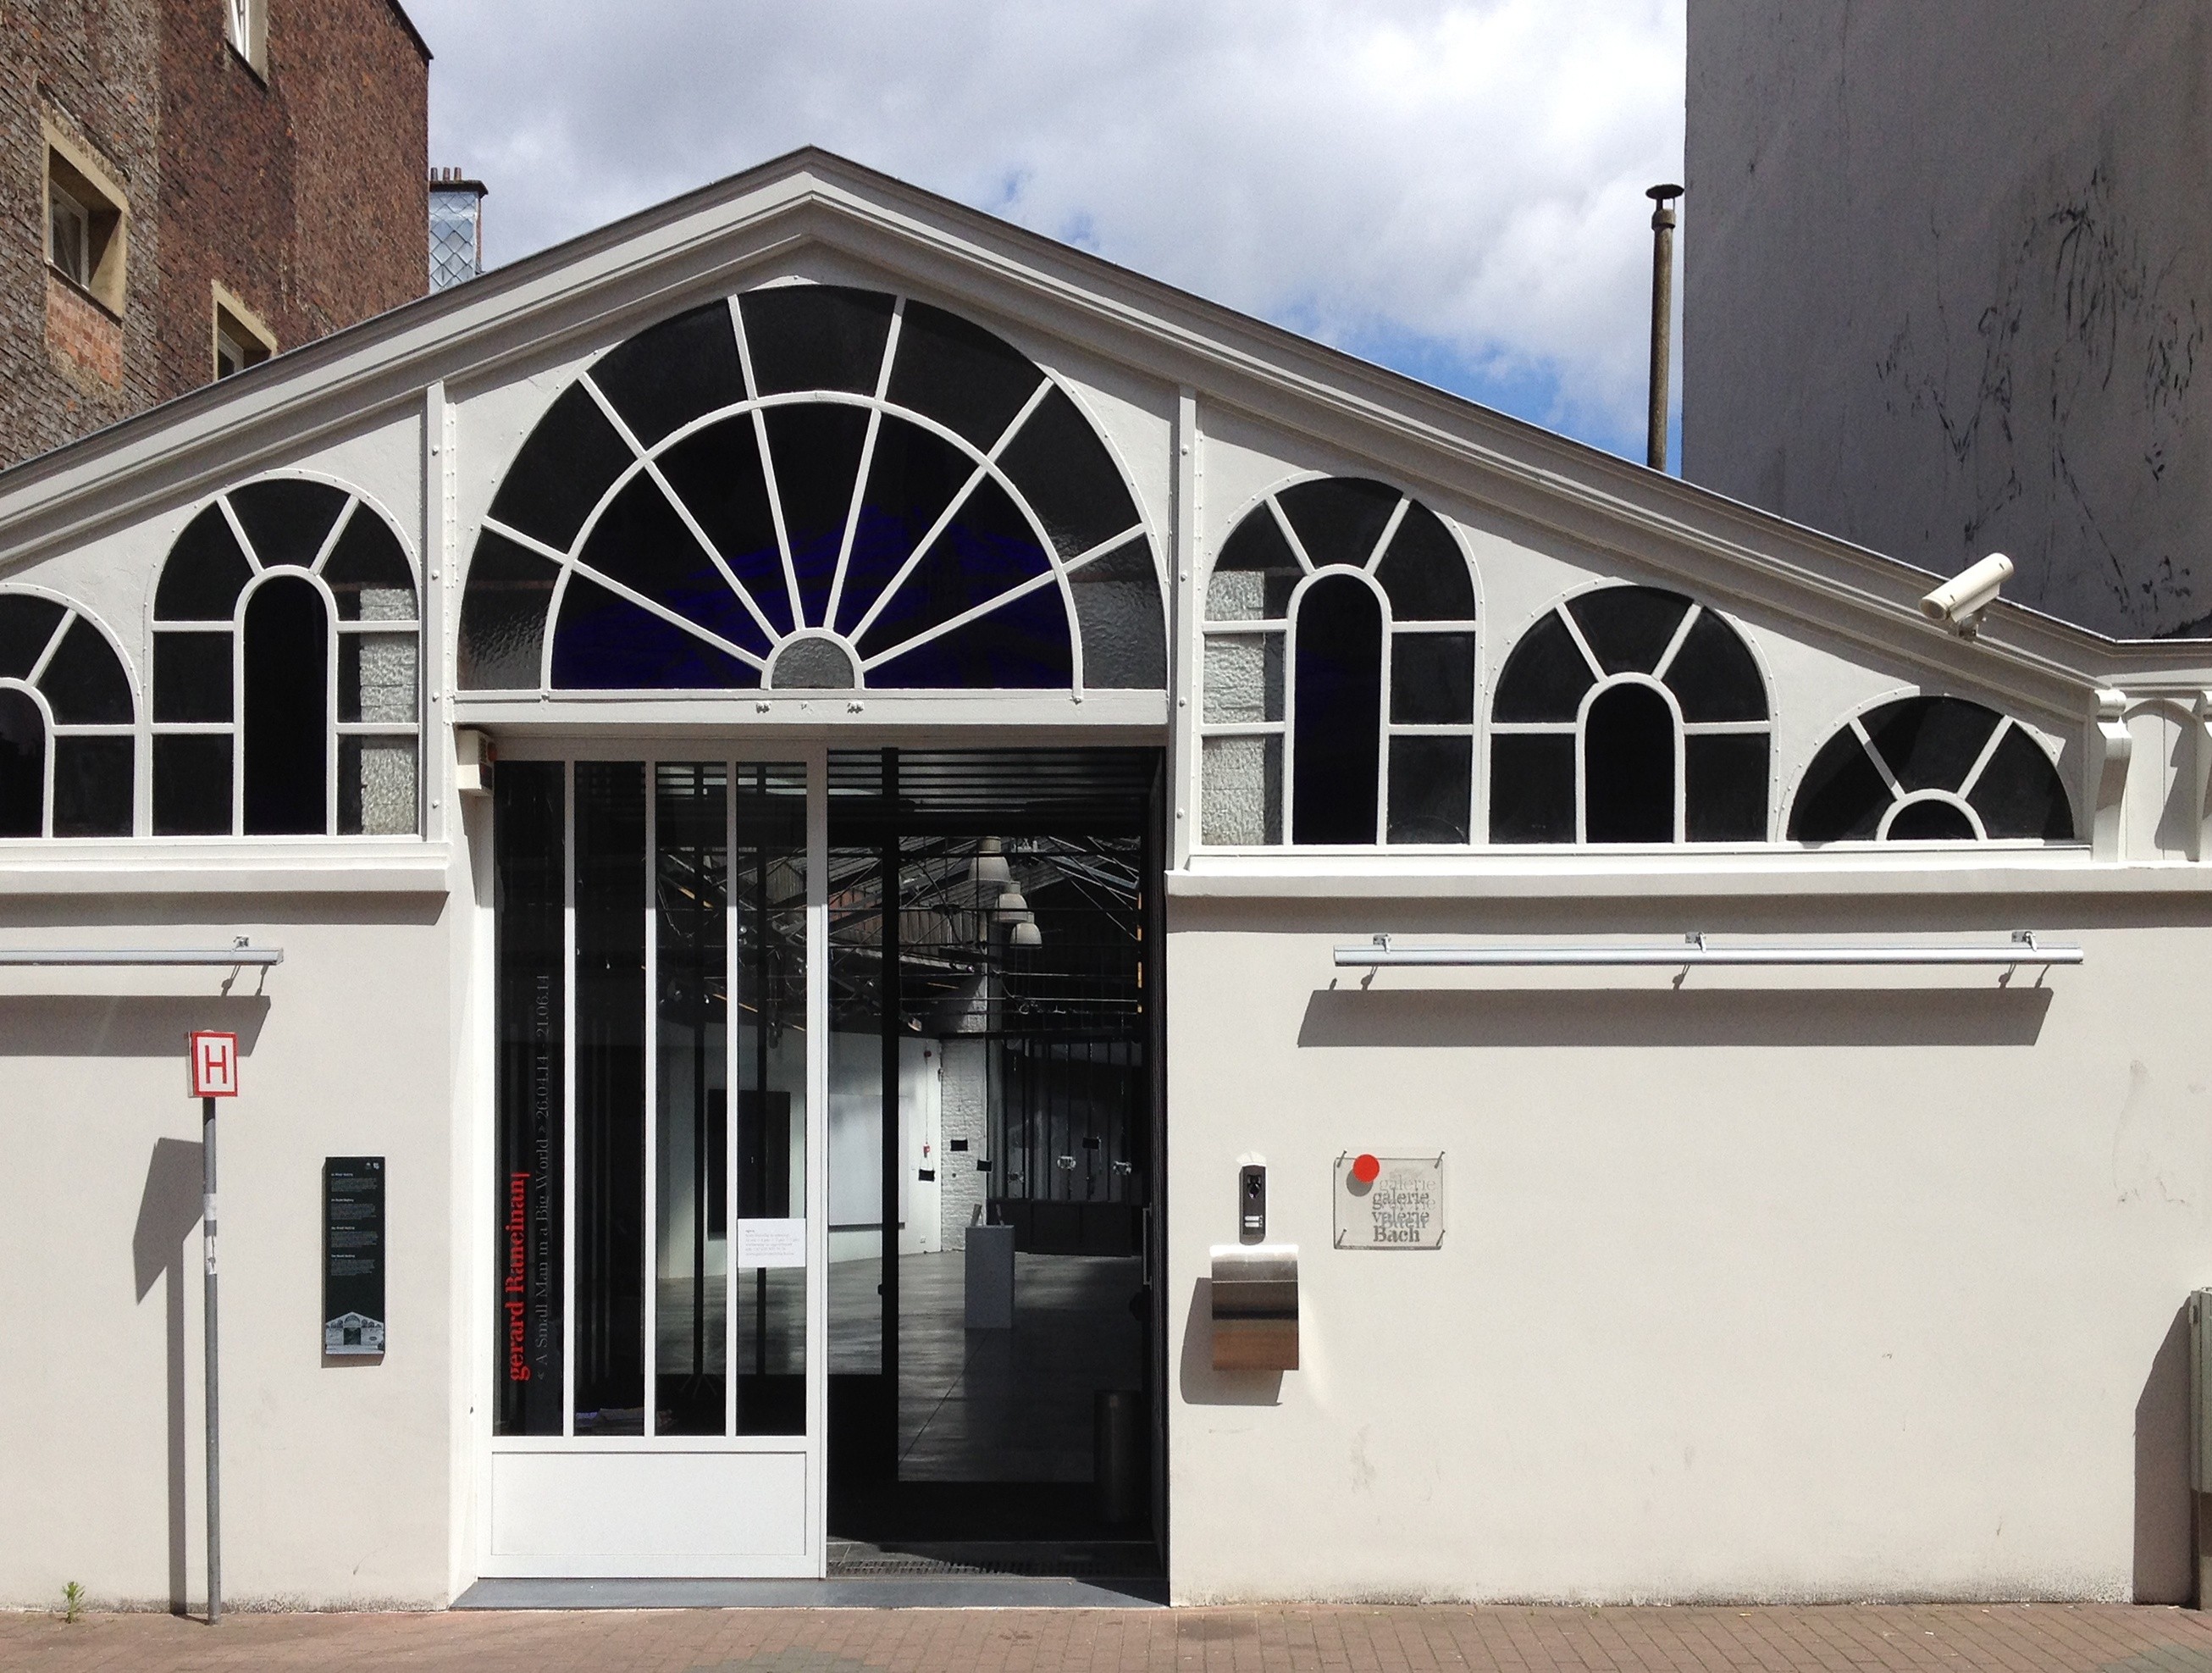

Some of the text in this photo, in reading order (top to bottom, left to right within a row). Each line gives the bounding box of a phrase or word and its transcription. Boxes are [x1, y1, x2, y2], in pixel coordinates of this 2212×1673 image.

[535, 974, 549, 1038] 21.06.14
[205, 1044, 227, 1084] H
[535, 1055, 549, 1120] 26.04.14
[535, 1138, 548, 1190] World
[535, 1195, 550, 1221] Big
[1372, 1187, 1430, 1210] galerie
[536, 1241, 548, 1255] in
[539, 1227, 548, 1236] a
[1373, 1225, 1420, 1243] Bach
[535, 1261, 548, 1298] Man
[504, 1301, 531, 1382] gerard
[535, 1304, 548, 1349] Small
[535, 1354, 548, 1366] A
